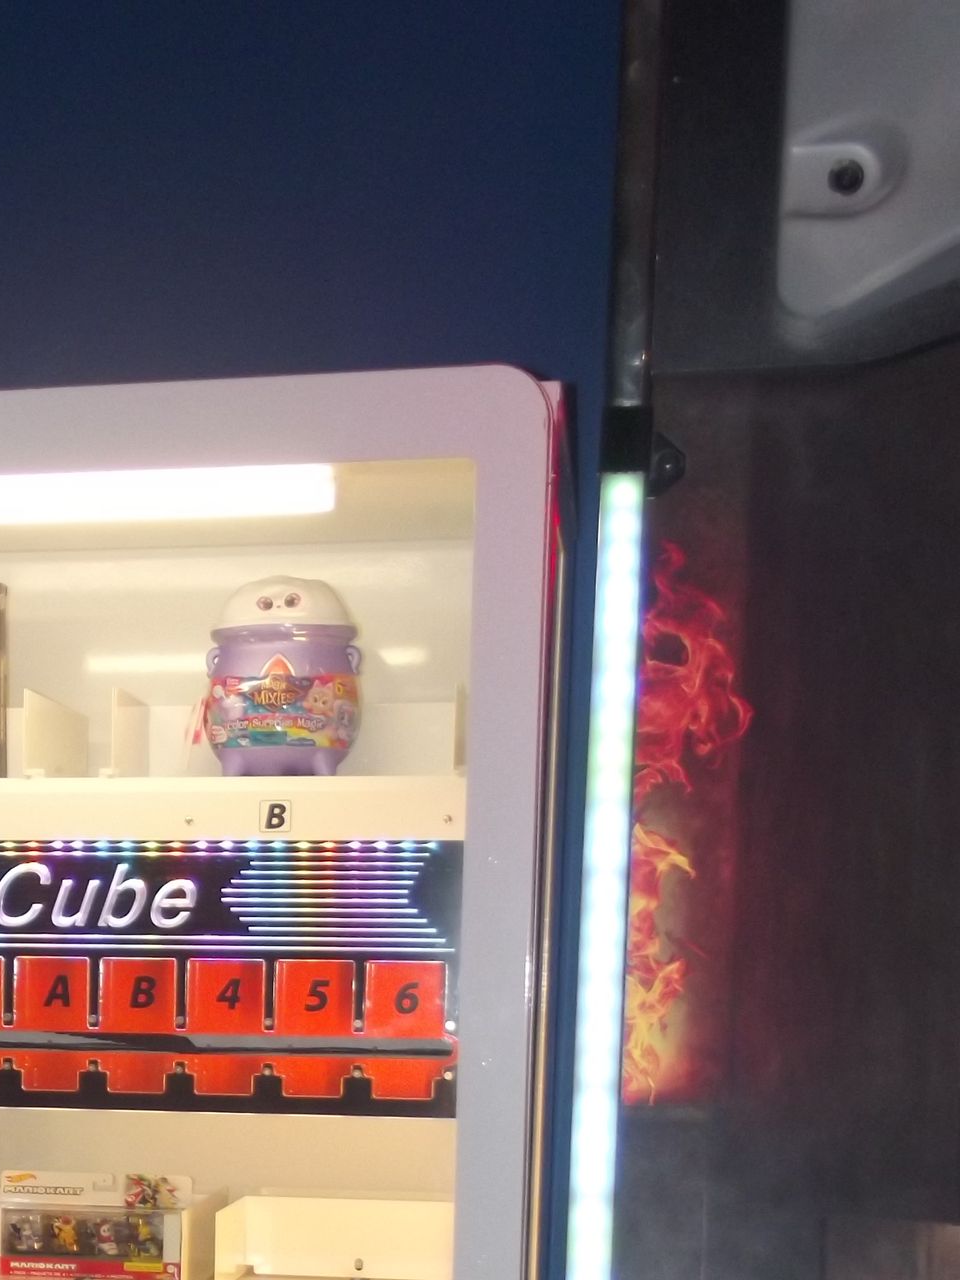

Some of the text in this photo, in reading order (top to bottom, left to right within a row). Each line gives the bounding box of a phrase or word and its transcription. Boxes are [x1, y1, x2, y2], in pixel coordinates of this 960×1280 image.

[265, 803, 287, 830] B
[43, 975, 71, 1008] A
[129, 976, 157, 1009] B
[215, 978, 241, 1011] 4
[304, 980, 330, 1013] 5
[394, 982, 420, 1014] 6
